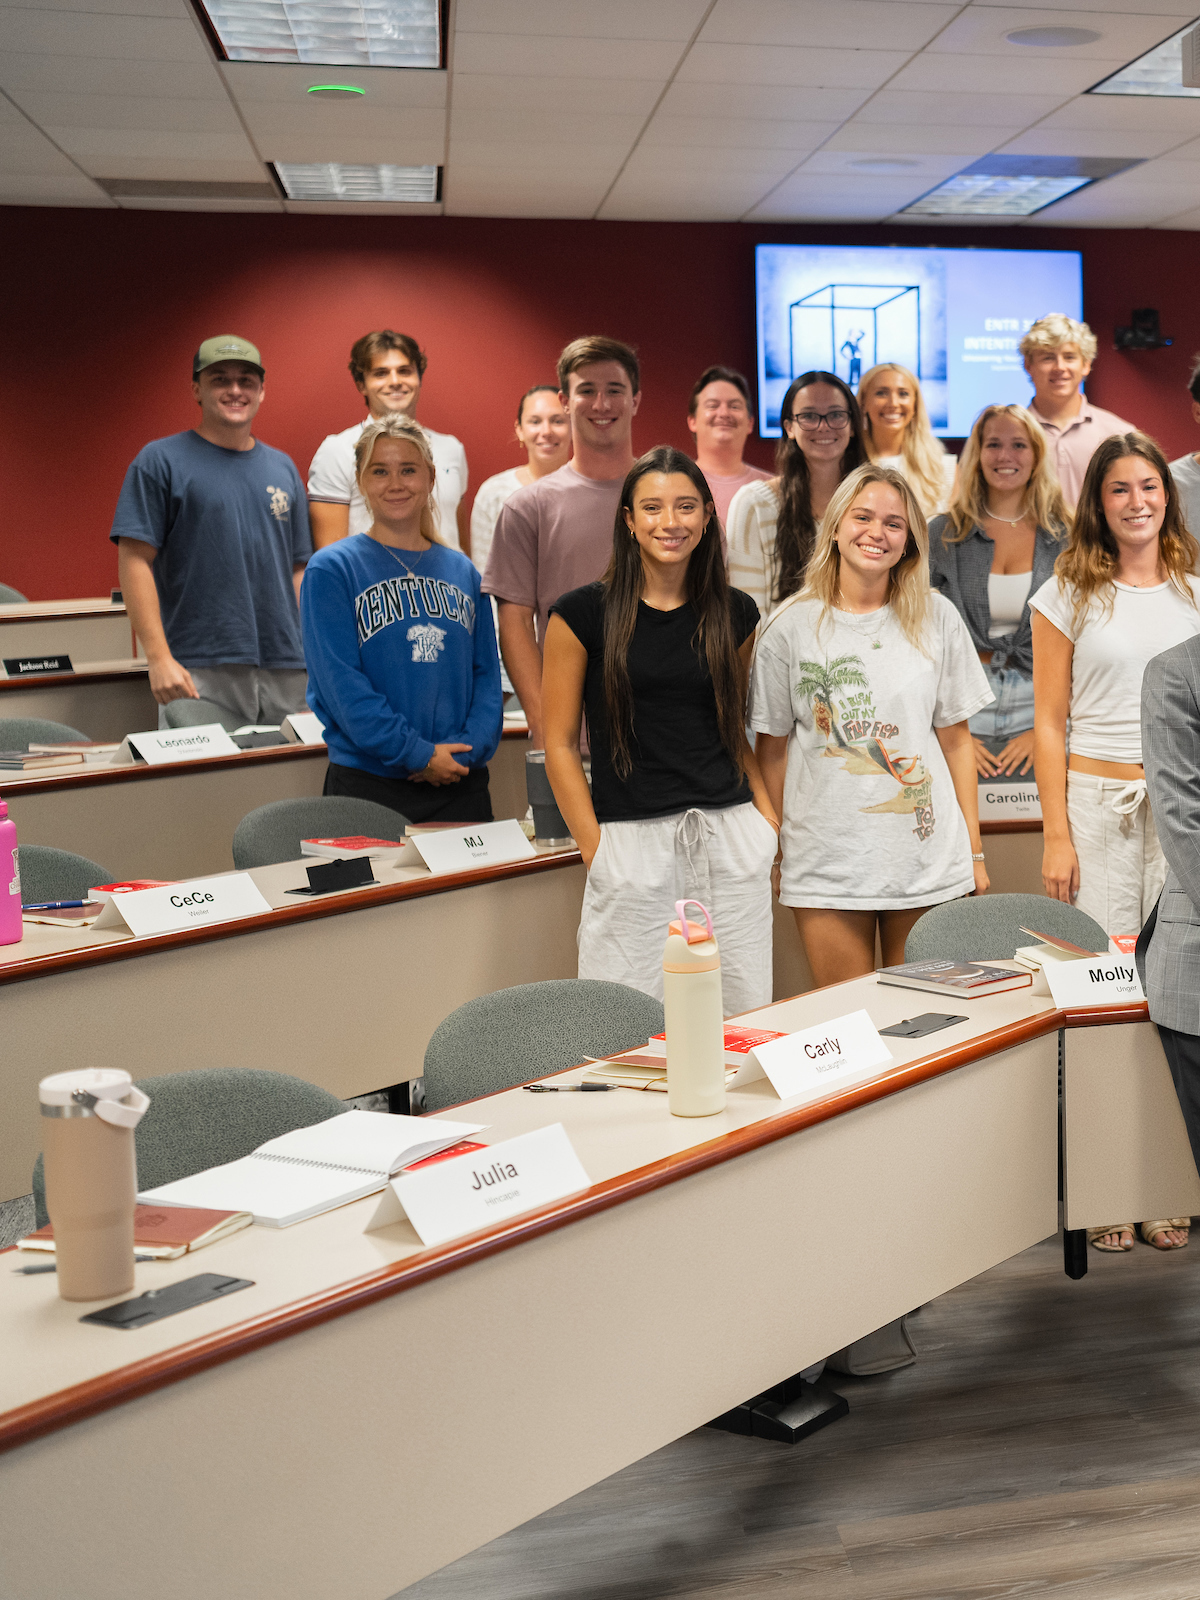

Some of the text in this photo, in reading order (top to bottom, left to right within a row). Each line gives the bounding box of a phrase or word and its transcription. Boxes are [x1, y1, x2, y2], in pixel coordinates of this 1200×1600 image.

[984, 317, 1019, 332] ENTR
[841, 706, 877, 721] OUT MY
[156, 735, 211, 749] Leonardo
[463, 835, 484, 849] MJ
[169, 891, 215, 908] CeCe
[1088, 965, 1134, 983] Molly
[1116, 985, 1138, 993] Unger
[803, 1037, 841, 1060] Carly
[471, 1162, 519, 1191] Julia
[484, 1190, 521, 1207] Hincapie
